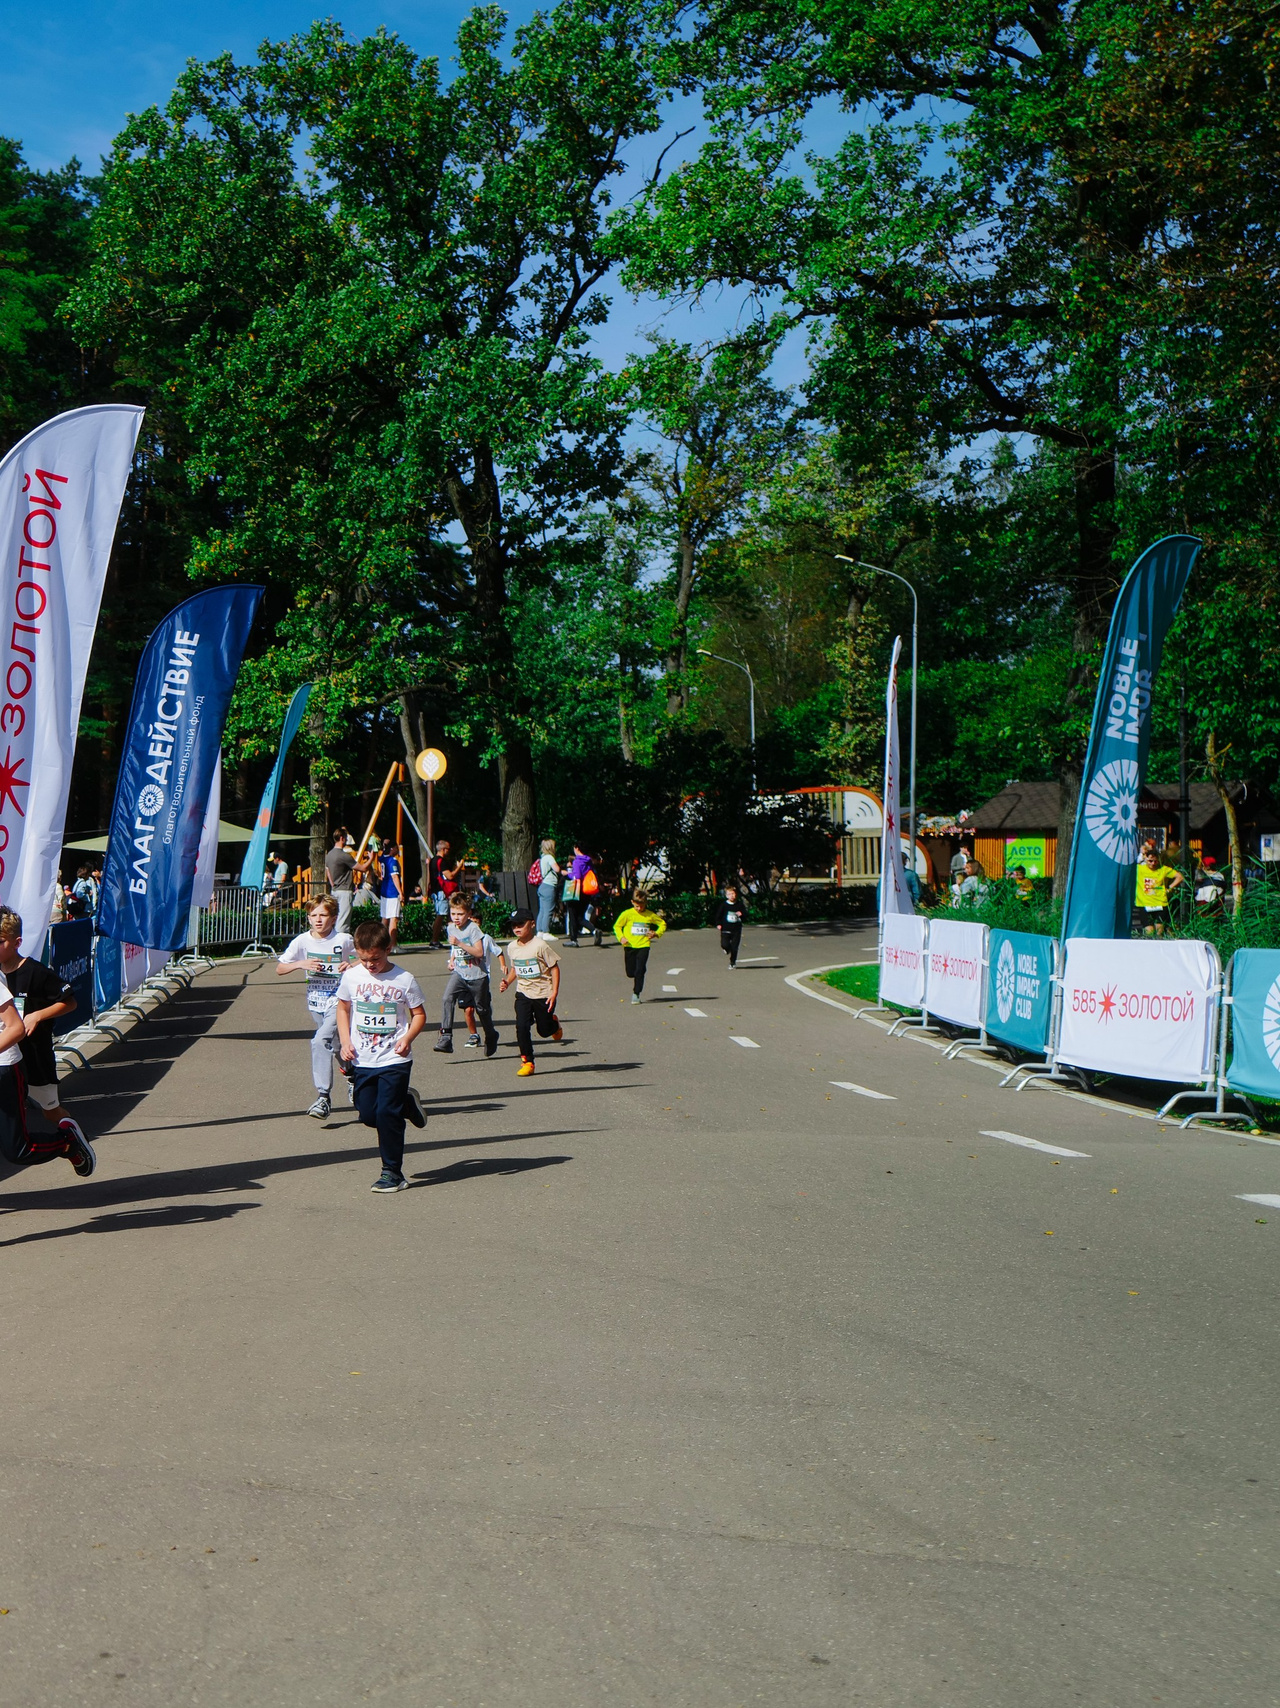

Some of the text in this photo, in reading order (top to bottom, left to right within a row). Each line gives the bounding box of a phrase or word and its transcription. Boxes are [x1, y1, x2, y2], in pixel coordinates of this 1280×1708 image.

[0, 467, 69, 738] ЗОЛОТОЙ
[1106, 636, 1139, 740] NOBLE
[161, 694, 205, 845] благотворительный фонд
[949, 957, 978, 981] ЗОЛОТОЙ
[1017, 953, 1038, 976] NOBLE
[355, 982, 403, 1000] NARUTO
[1016, 975, 1040, 999] IMPACT
[1015, 998, 1032, 1020] CLUB
[1072, 988, 1194, 1022] 585 ЗОЛОТОЙ
[364, 1015, 387, 1026] 514
